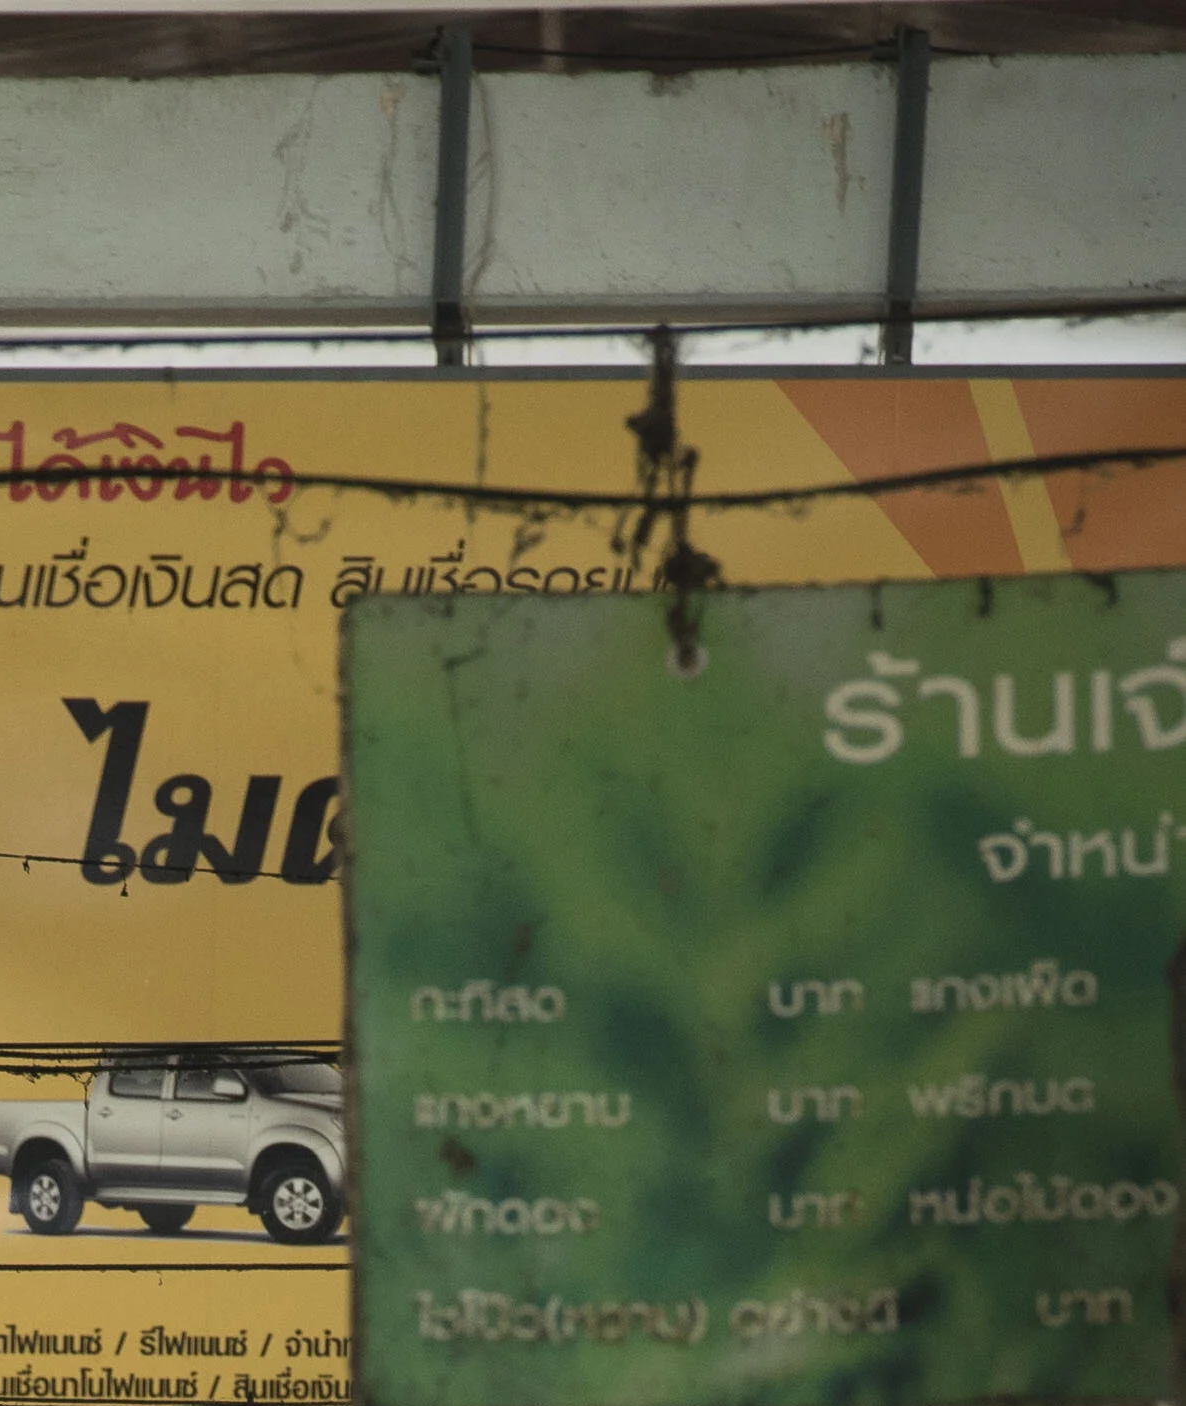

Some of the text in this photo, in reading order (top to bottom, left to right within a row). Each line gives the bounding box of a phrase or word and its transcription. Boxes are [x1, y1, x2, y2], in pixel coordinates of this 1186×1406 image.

[769, 976, 865, 1018] บาท
[768, 1084, 865, 1124] บาท
[1035, 1287, 1135, 1328] บาท
[140, 1325, 247, 1357] รีไฟแนนซ์
